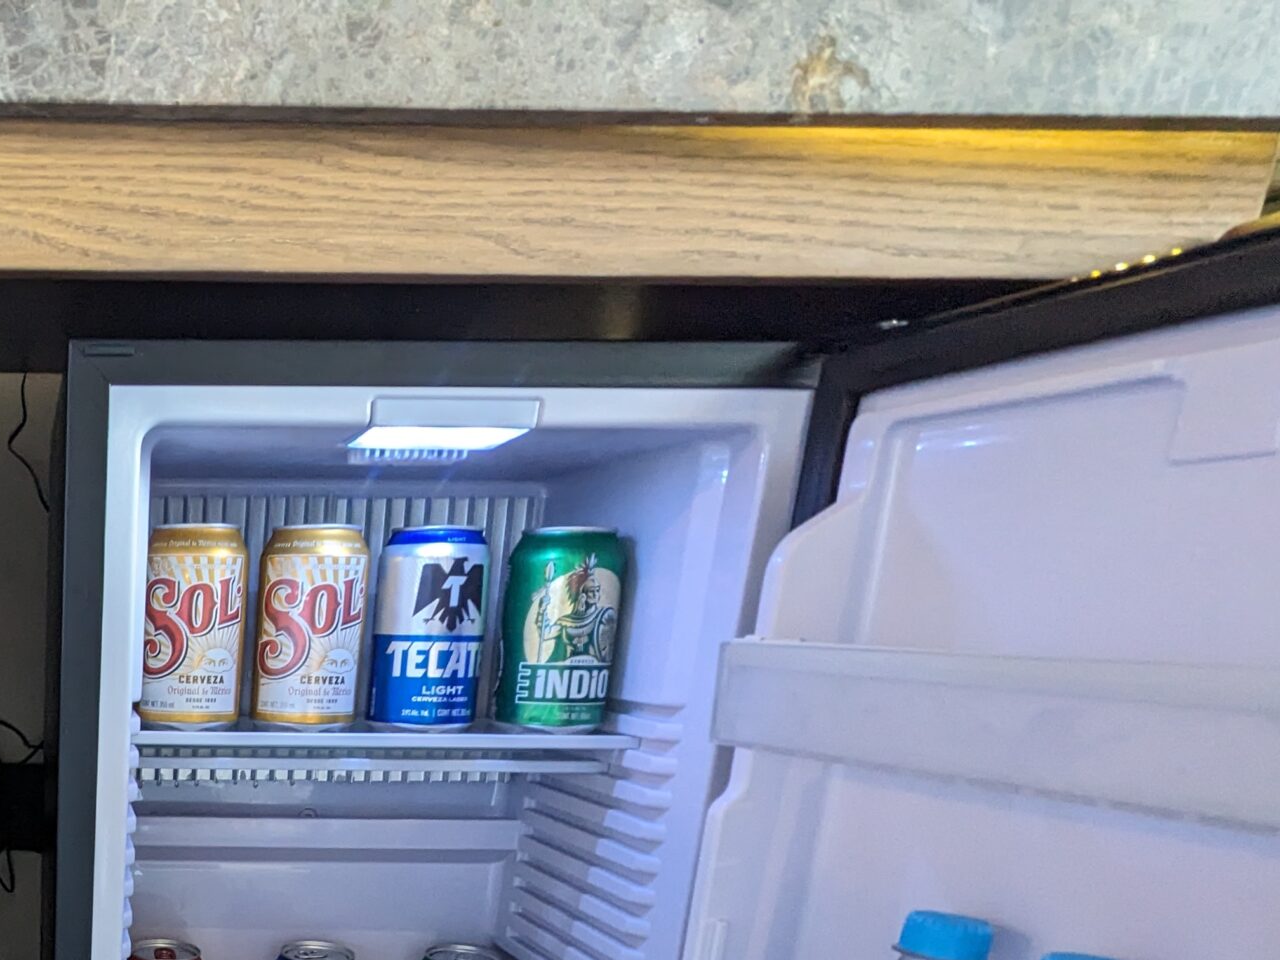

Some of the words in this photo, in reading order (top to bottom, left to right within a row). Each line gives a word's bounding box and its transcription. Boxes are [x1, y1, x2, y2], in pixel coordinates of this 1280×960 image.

[441, 575, 468, 608] T
[144, 577, 242, 679] SOL
[258, 577, 365, 680] SOL
[385, 640, 482, 678] TECAT
[178, 675, 225, 684] CERVEZA
[299, 675, 346, 685] CERVEZA
[421, 685, 464, 695] LIGHT
